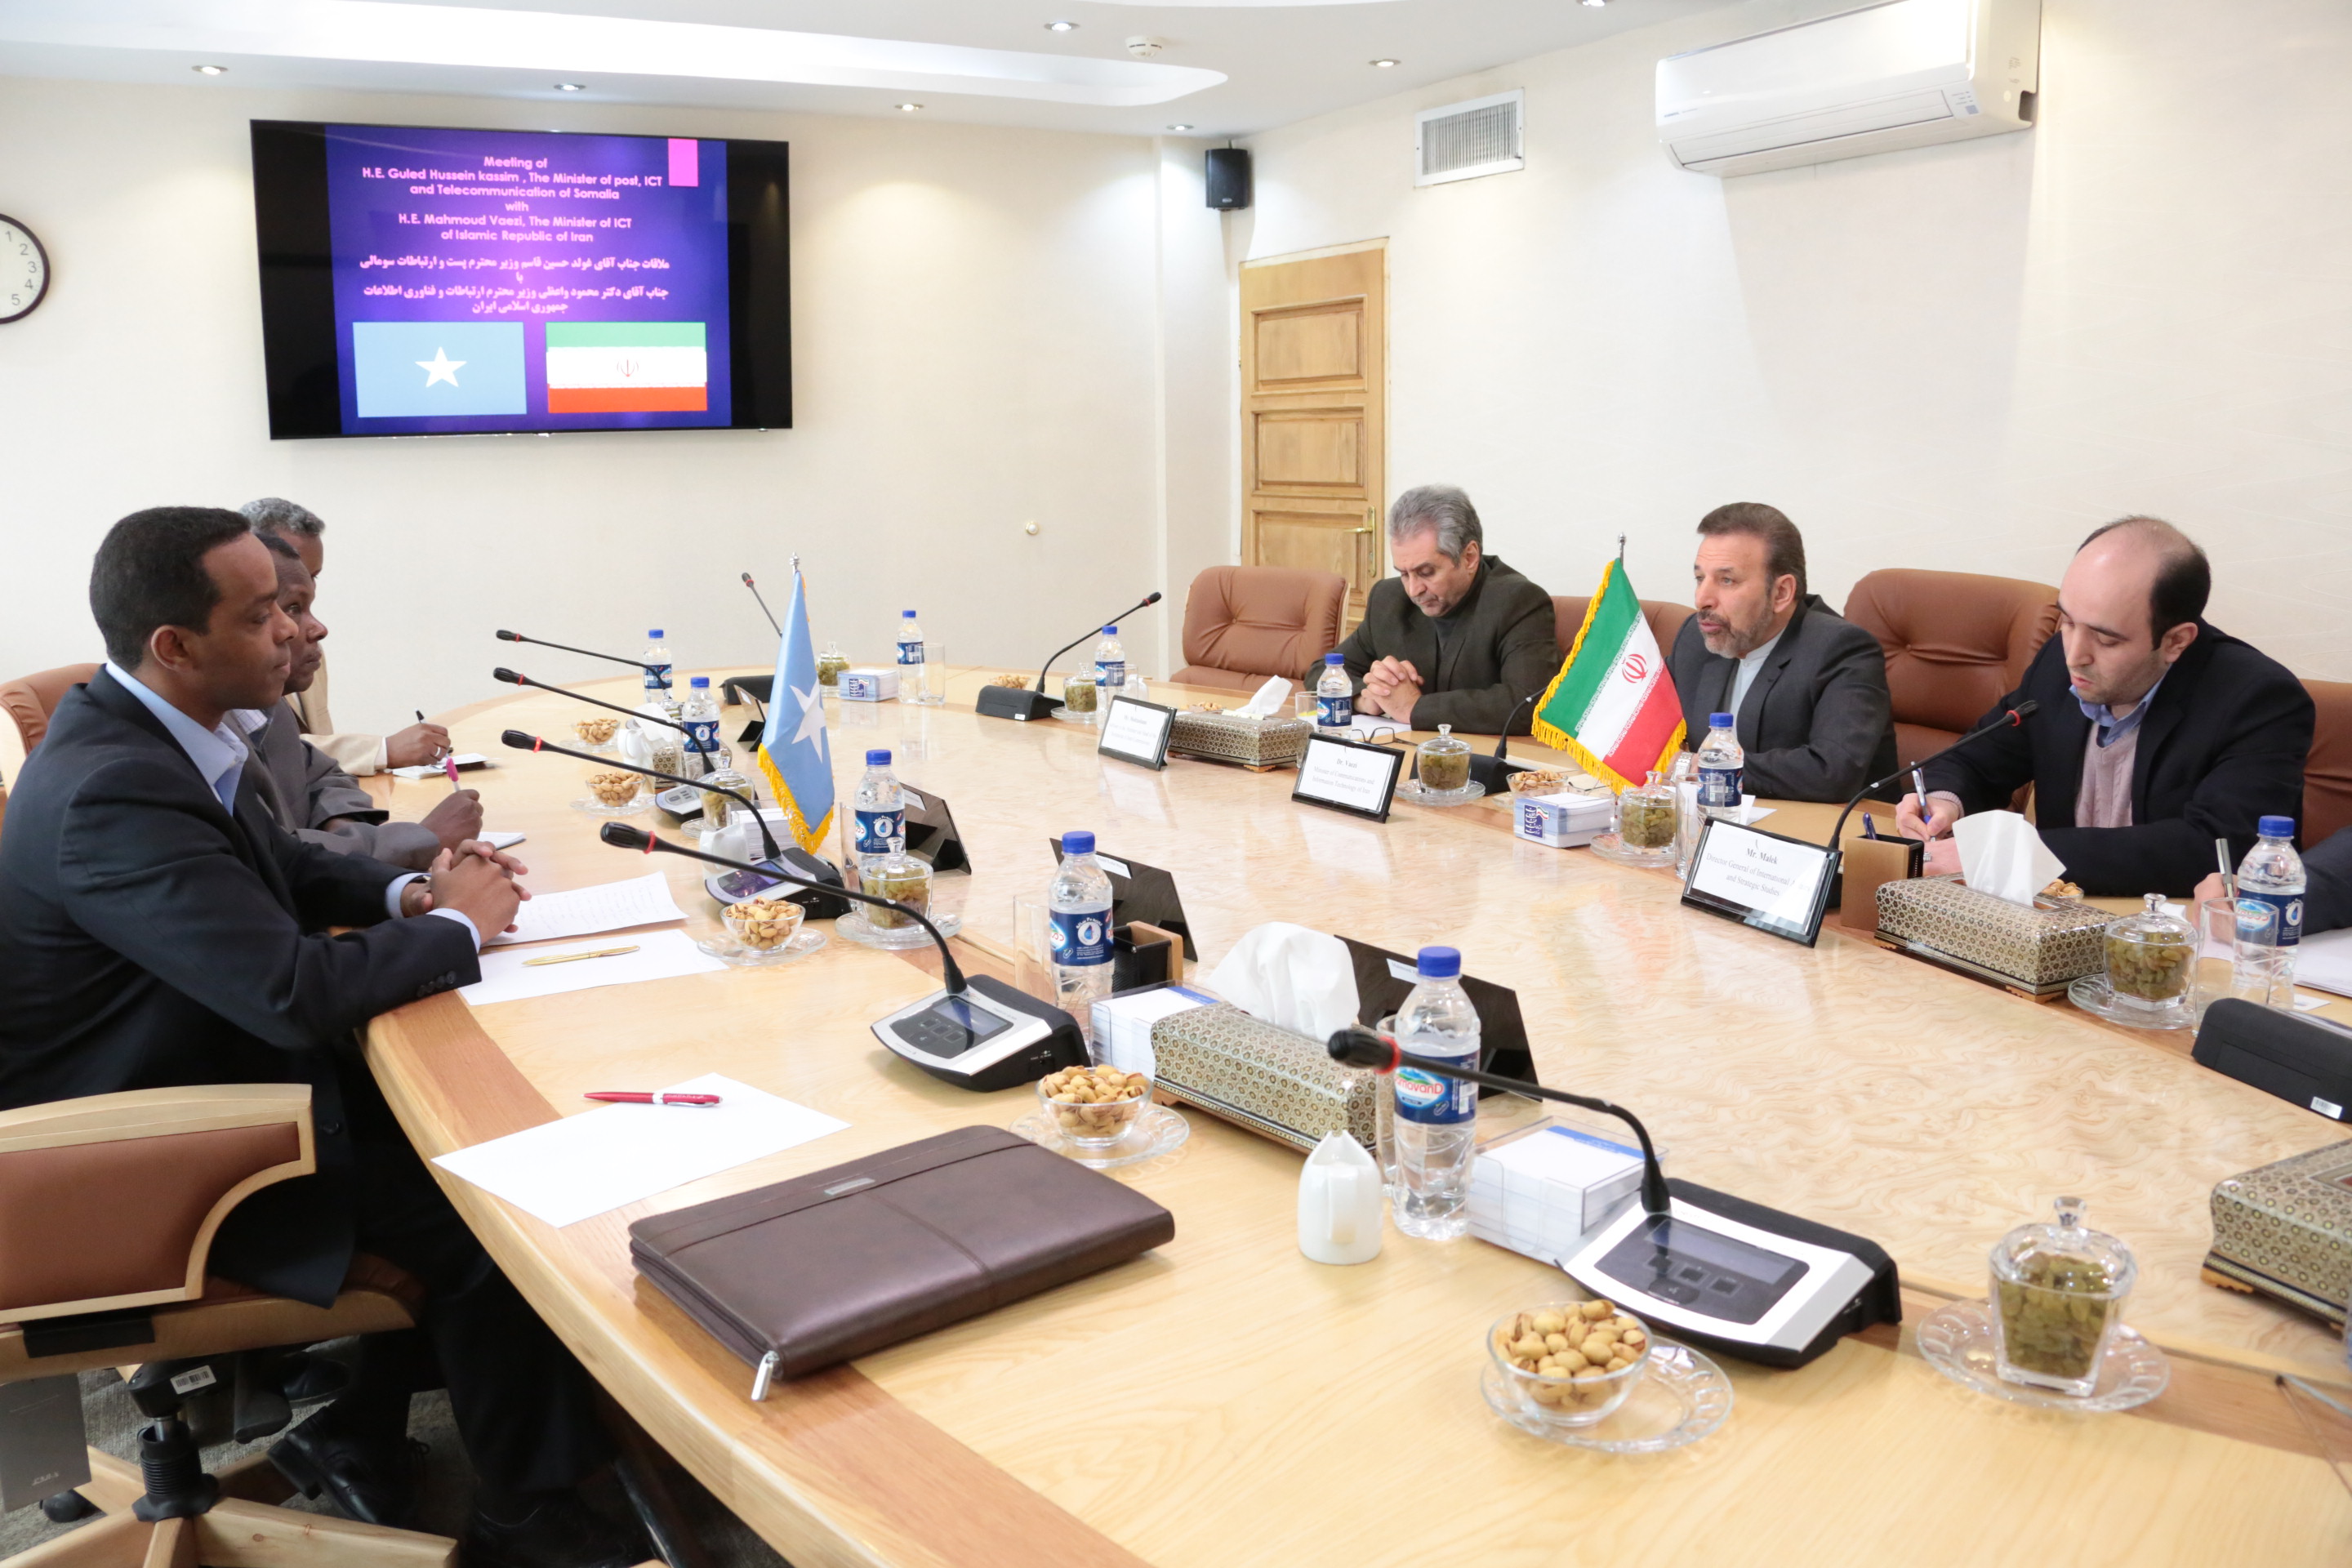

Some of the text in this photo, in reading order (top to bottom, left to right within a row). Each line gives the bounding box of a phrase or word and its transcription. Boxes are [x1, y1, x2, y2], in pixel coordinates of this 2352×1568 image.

[483, 156, 548, 170] Meeting of
[362, 167, 385, 178] H.E.
[388, 168, 426, 180] Guled
[430, 169, 475, 180] Hussein
[478, 171, 519, 182] kassim
[529, 172, 550, 184] The
[553, 173, 597, 185] Minister
[600, 175, 612, 185] of
[614, 176, 642, 188] post,
[644, 176, 663, 186] ICT
[410, 184, 620, 199] and Telecommunication of Somalia
[505, 201, 529, 212] with
[399, 213, 632, 229] H.E. Mahmoud Vaezi, The Minister of ICT
[5, 230, 12, 243] 1
[441, 229, 594, 243] of Islamic Republic of Iran
[20, 243, 29, 256] 2
[27, 261, 37, 274] 3
[397, 256, 437, 269] ارتباطات
[499, 258, 519, 270] وزیر
[543, 259, 569, 270] حسین
[617, 258, 640, 271] جناب
[642, 257, 670, 269] ملاقات
[24, 278, 33, 290] 4
[445, 286, 485, 298] ارتباطات
[517, 287, 537, 299] وزیر
[571, 288, 599, 299] محمود
[601, 287, 621, 299] دکتر
[646, 287, 669, 300] جناب
[11, 293, 20, 305] 5
[1746, 848, 1779, 865] Mr. Malek
[1706, 853, 1728, 866] Director
[1728, 859, 1748, 873] General
[1749, 865, 1757, 875] of
[1726, 874, 1738, 883] and
[1738, 876, 1761, 891] Strategic
